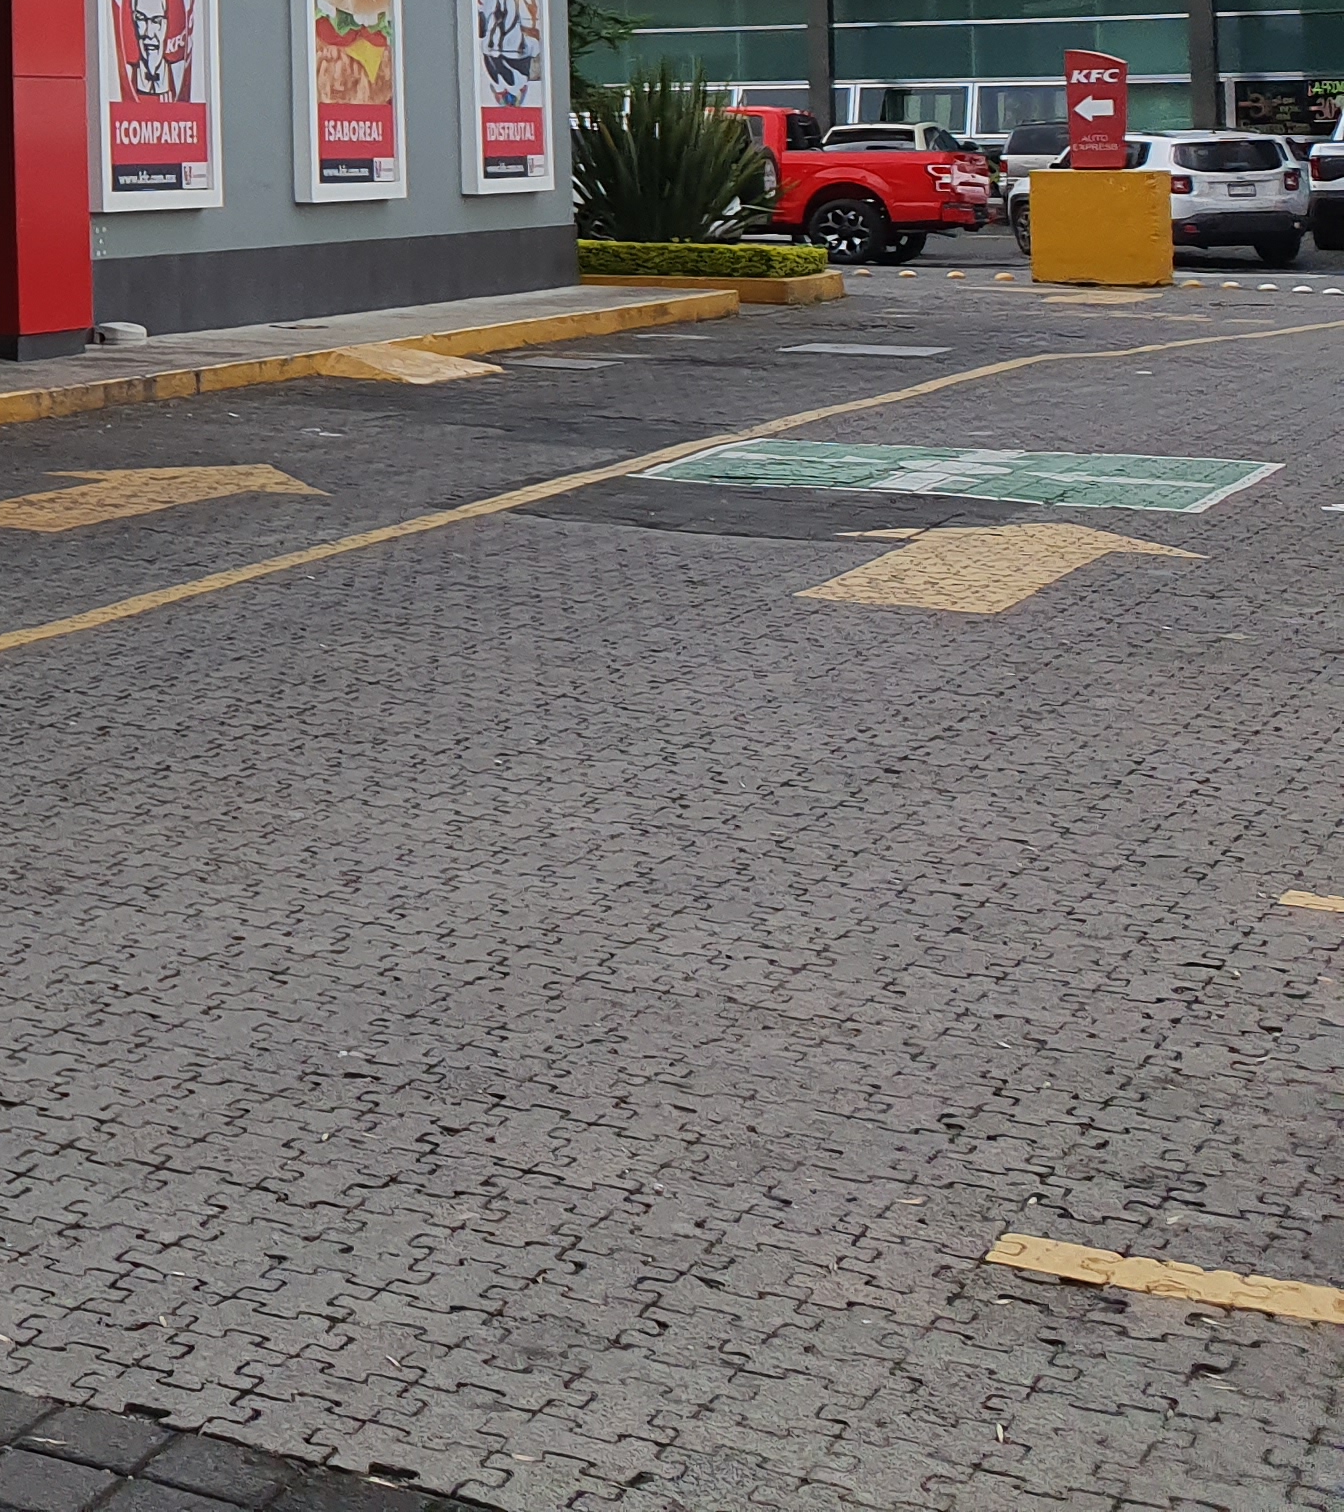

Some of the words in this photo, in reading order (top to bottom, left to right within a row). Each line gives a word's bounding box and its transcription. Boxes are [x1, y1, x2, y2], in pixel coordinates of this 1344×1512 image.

[1071, 69, 1120, 83] KFC
[116, 121, 198, 144] ¡COMPARTE!
[325, 120, 382, 141] ¡SABOREA!
[486, 122, 534, 141] ¡DISFRUTA!
[1081, 134, 1108, 142] AUTO
[1073, 143, 1119, 151] EXPRESS
